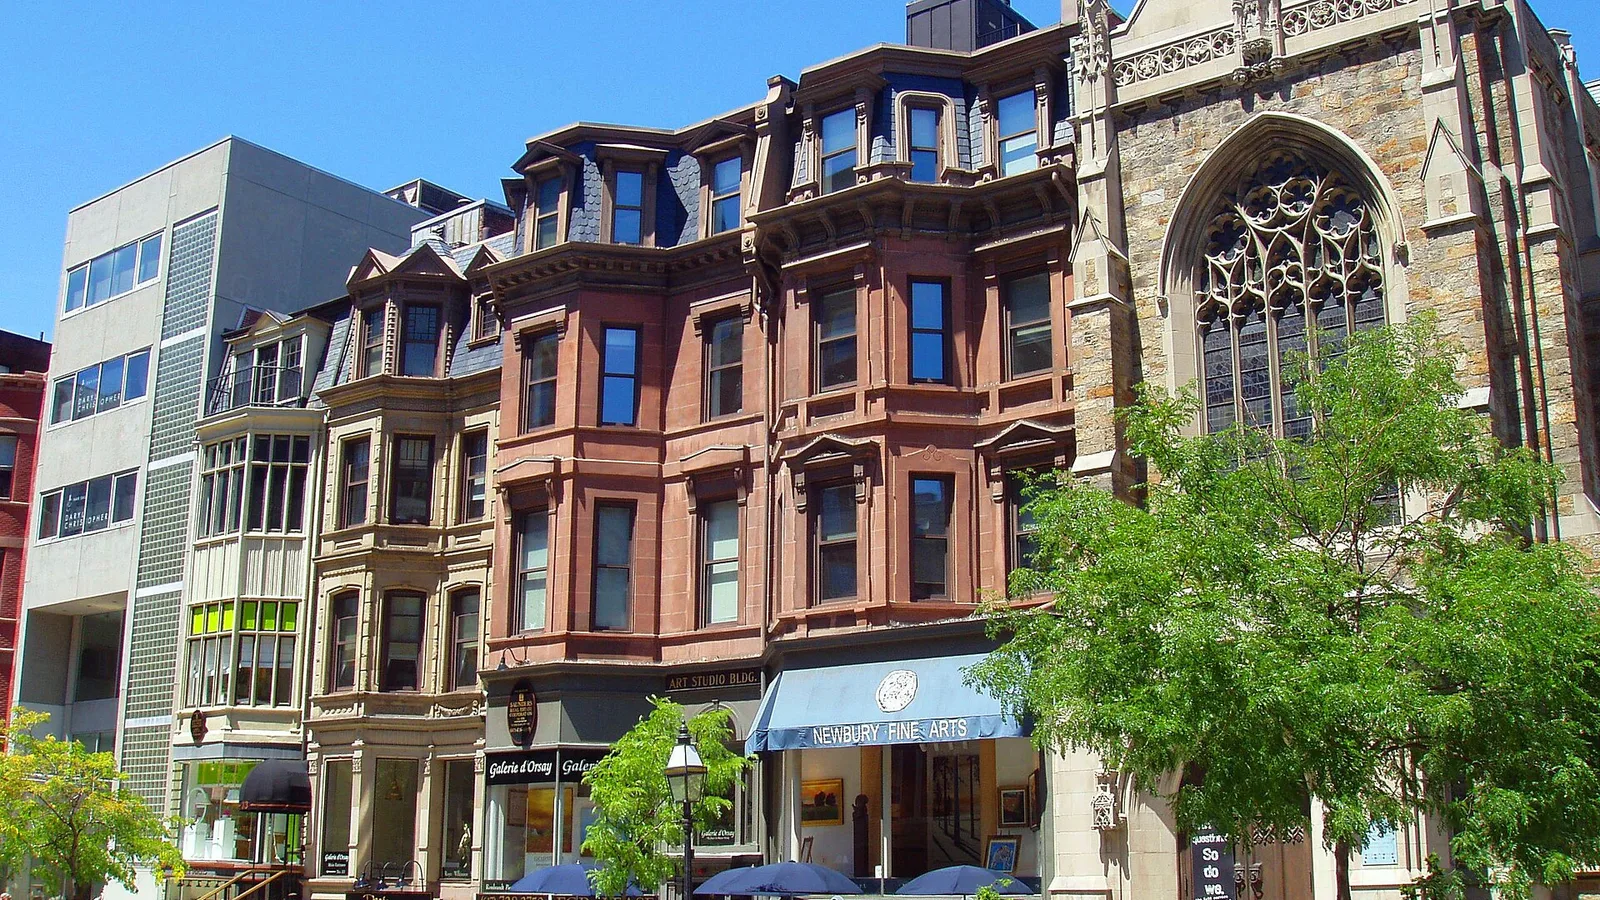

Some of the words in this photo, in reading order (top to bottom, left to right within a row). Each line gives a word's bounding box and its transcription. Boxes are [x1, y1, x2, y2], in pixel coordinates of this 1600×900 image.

[669, 677, 688, 689] ART
[692, 674, 725, 687] STUDIO
[730, 672, 757, 684] BLDG.
[813, 722, 879, 744] NEWBURY
[888, 721, 919, 740] FINE
[928, 719, 967, 737] ARTS
[489, 761, 519, 778] Galerie
[520, 760, 552, 775] d'Orsay
[1202, 847, 1219, 861] So
[1203, 865, 1219, 878] do
[1204, 884, 1225, 895] we.
